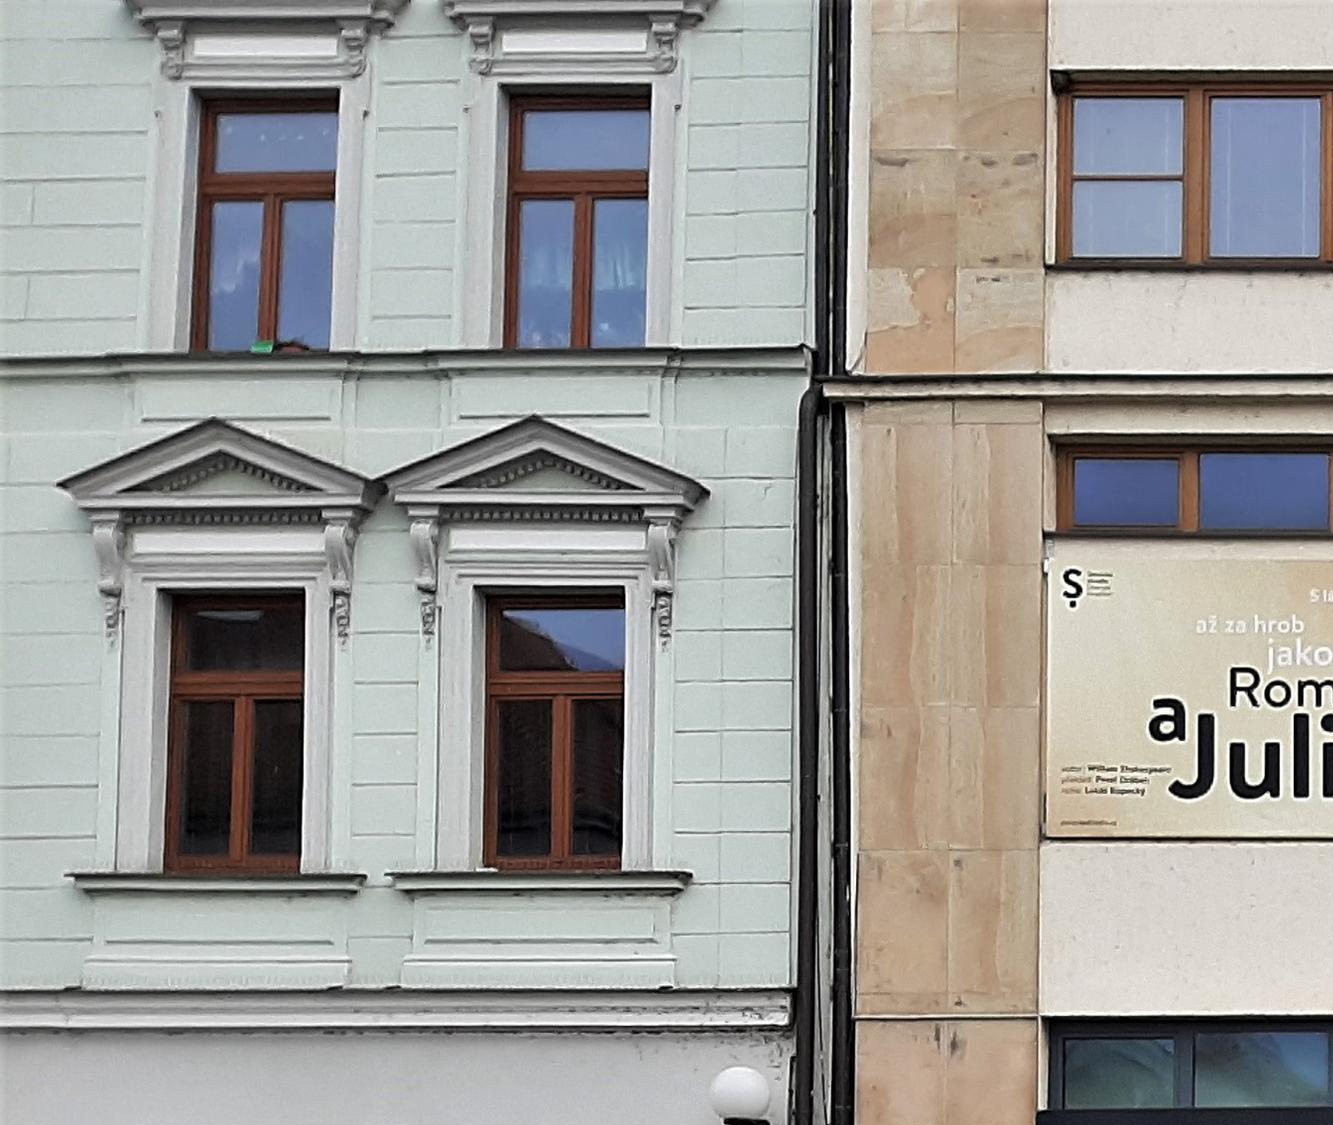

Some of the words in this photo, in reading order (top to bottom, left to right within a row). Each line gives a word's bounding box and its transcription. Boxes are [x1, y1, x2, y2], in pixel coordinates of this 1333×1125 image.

[1195, 615, 1217, 634] až
[1225, 619, 1246, 634] za
[1254, 615, 1305, 634] hrob
[1268, 638, 1333, 673] jako
[1148, 697, 1187, 741] a
